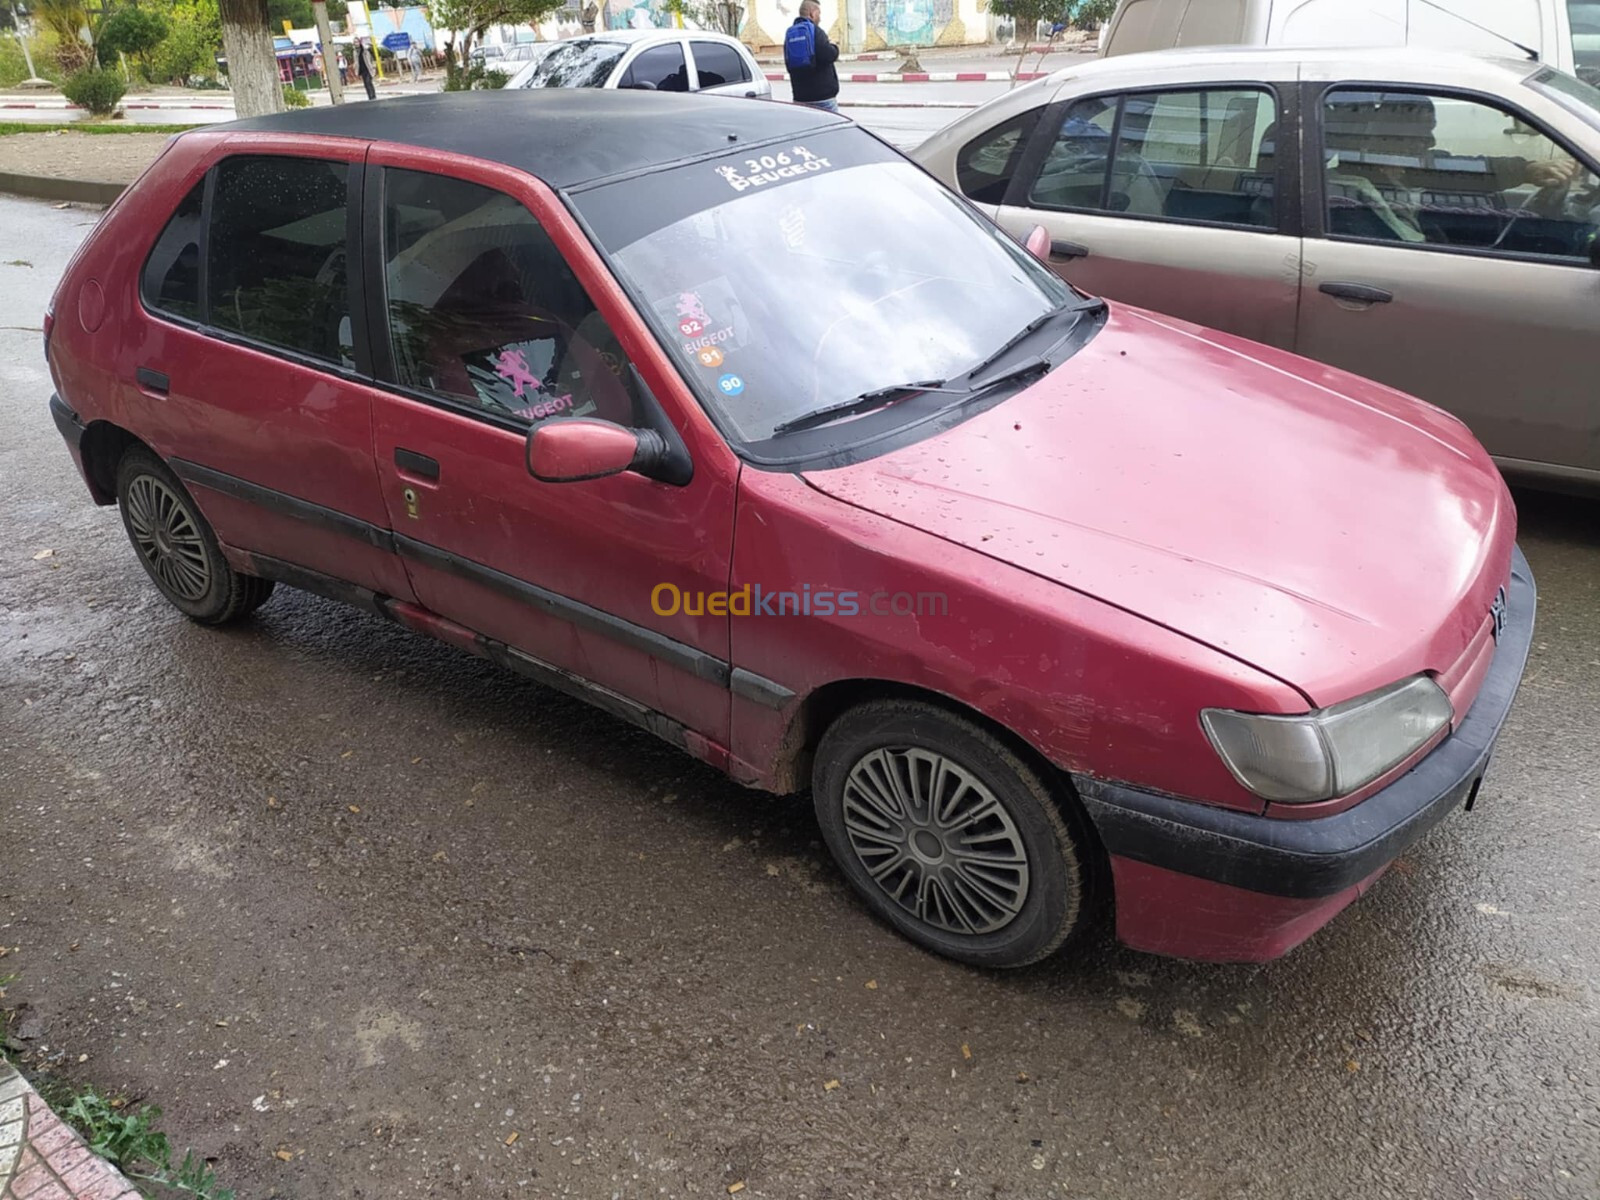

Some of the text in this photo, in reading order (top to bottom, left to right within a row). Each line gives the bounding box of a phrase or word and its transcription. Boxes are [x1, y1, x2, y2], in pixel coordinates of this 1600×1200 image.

[745, 152, 791, 173] 306
[730, 158, 832, 191] PEUGEOT
[681, 321, 702, 335] 92
[701, 350, 720, 364] 91
[721, 377, 741, 391] 90
